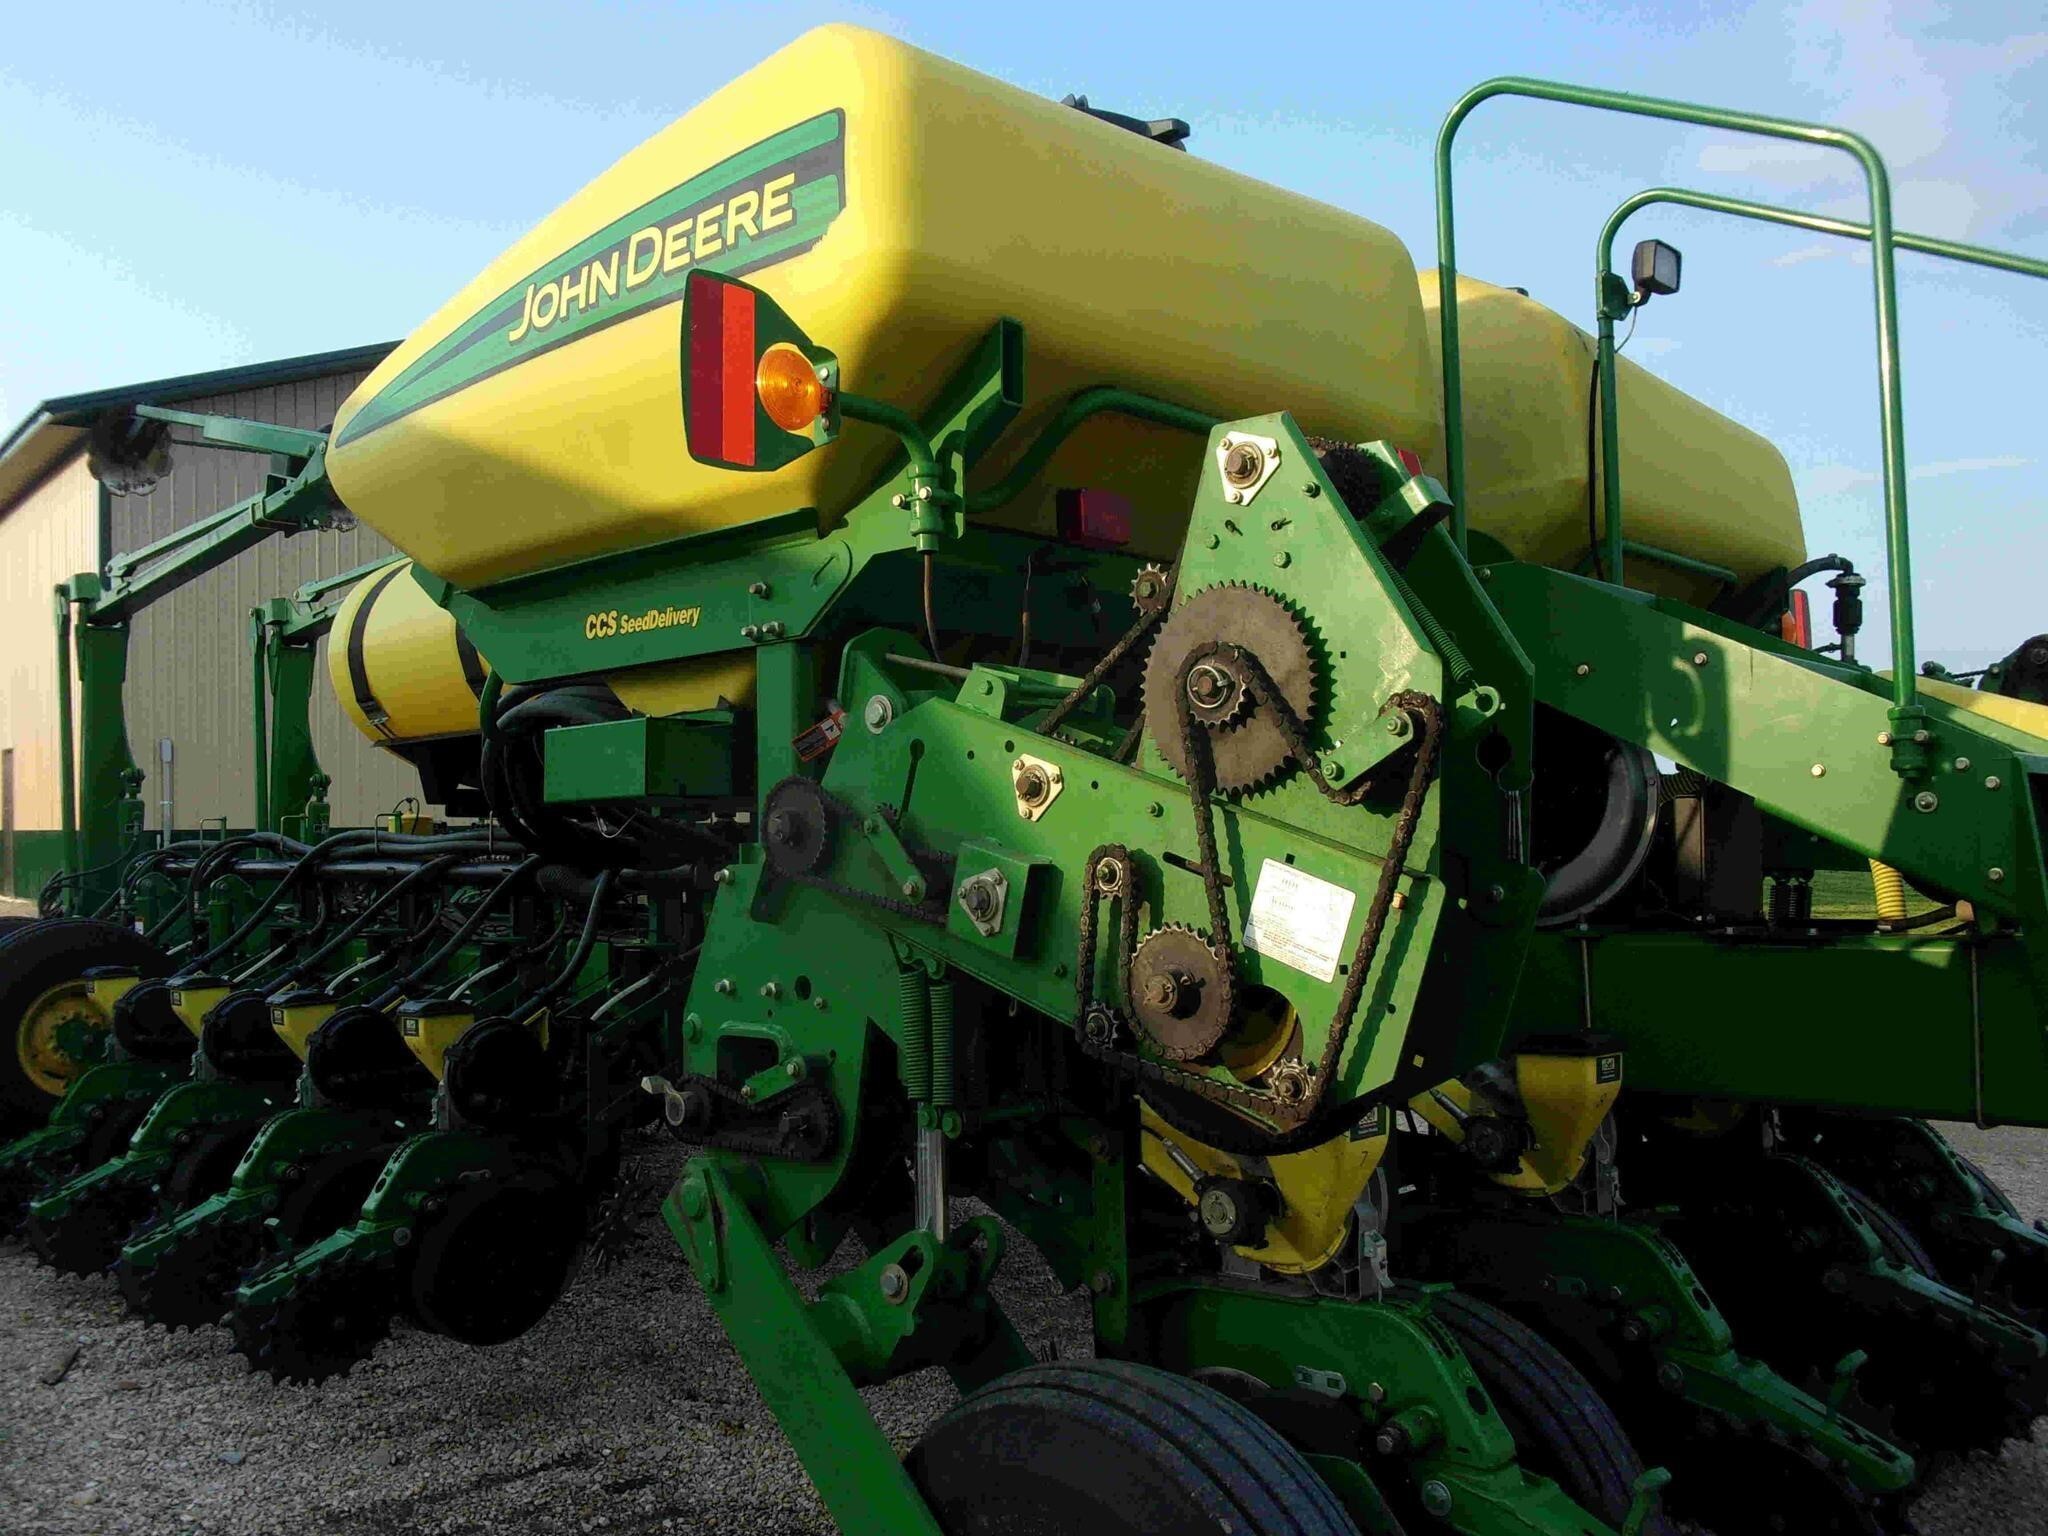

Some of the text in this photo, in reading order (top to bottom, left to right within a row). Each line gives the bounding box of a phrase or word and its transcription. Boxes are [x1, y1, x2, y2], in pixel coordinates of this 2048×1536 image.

[508, 172, 796, 343] JOHN DEERE
[585, 606, 701, 639] CCS SeedDelivery
